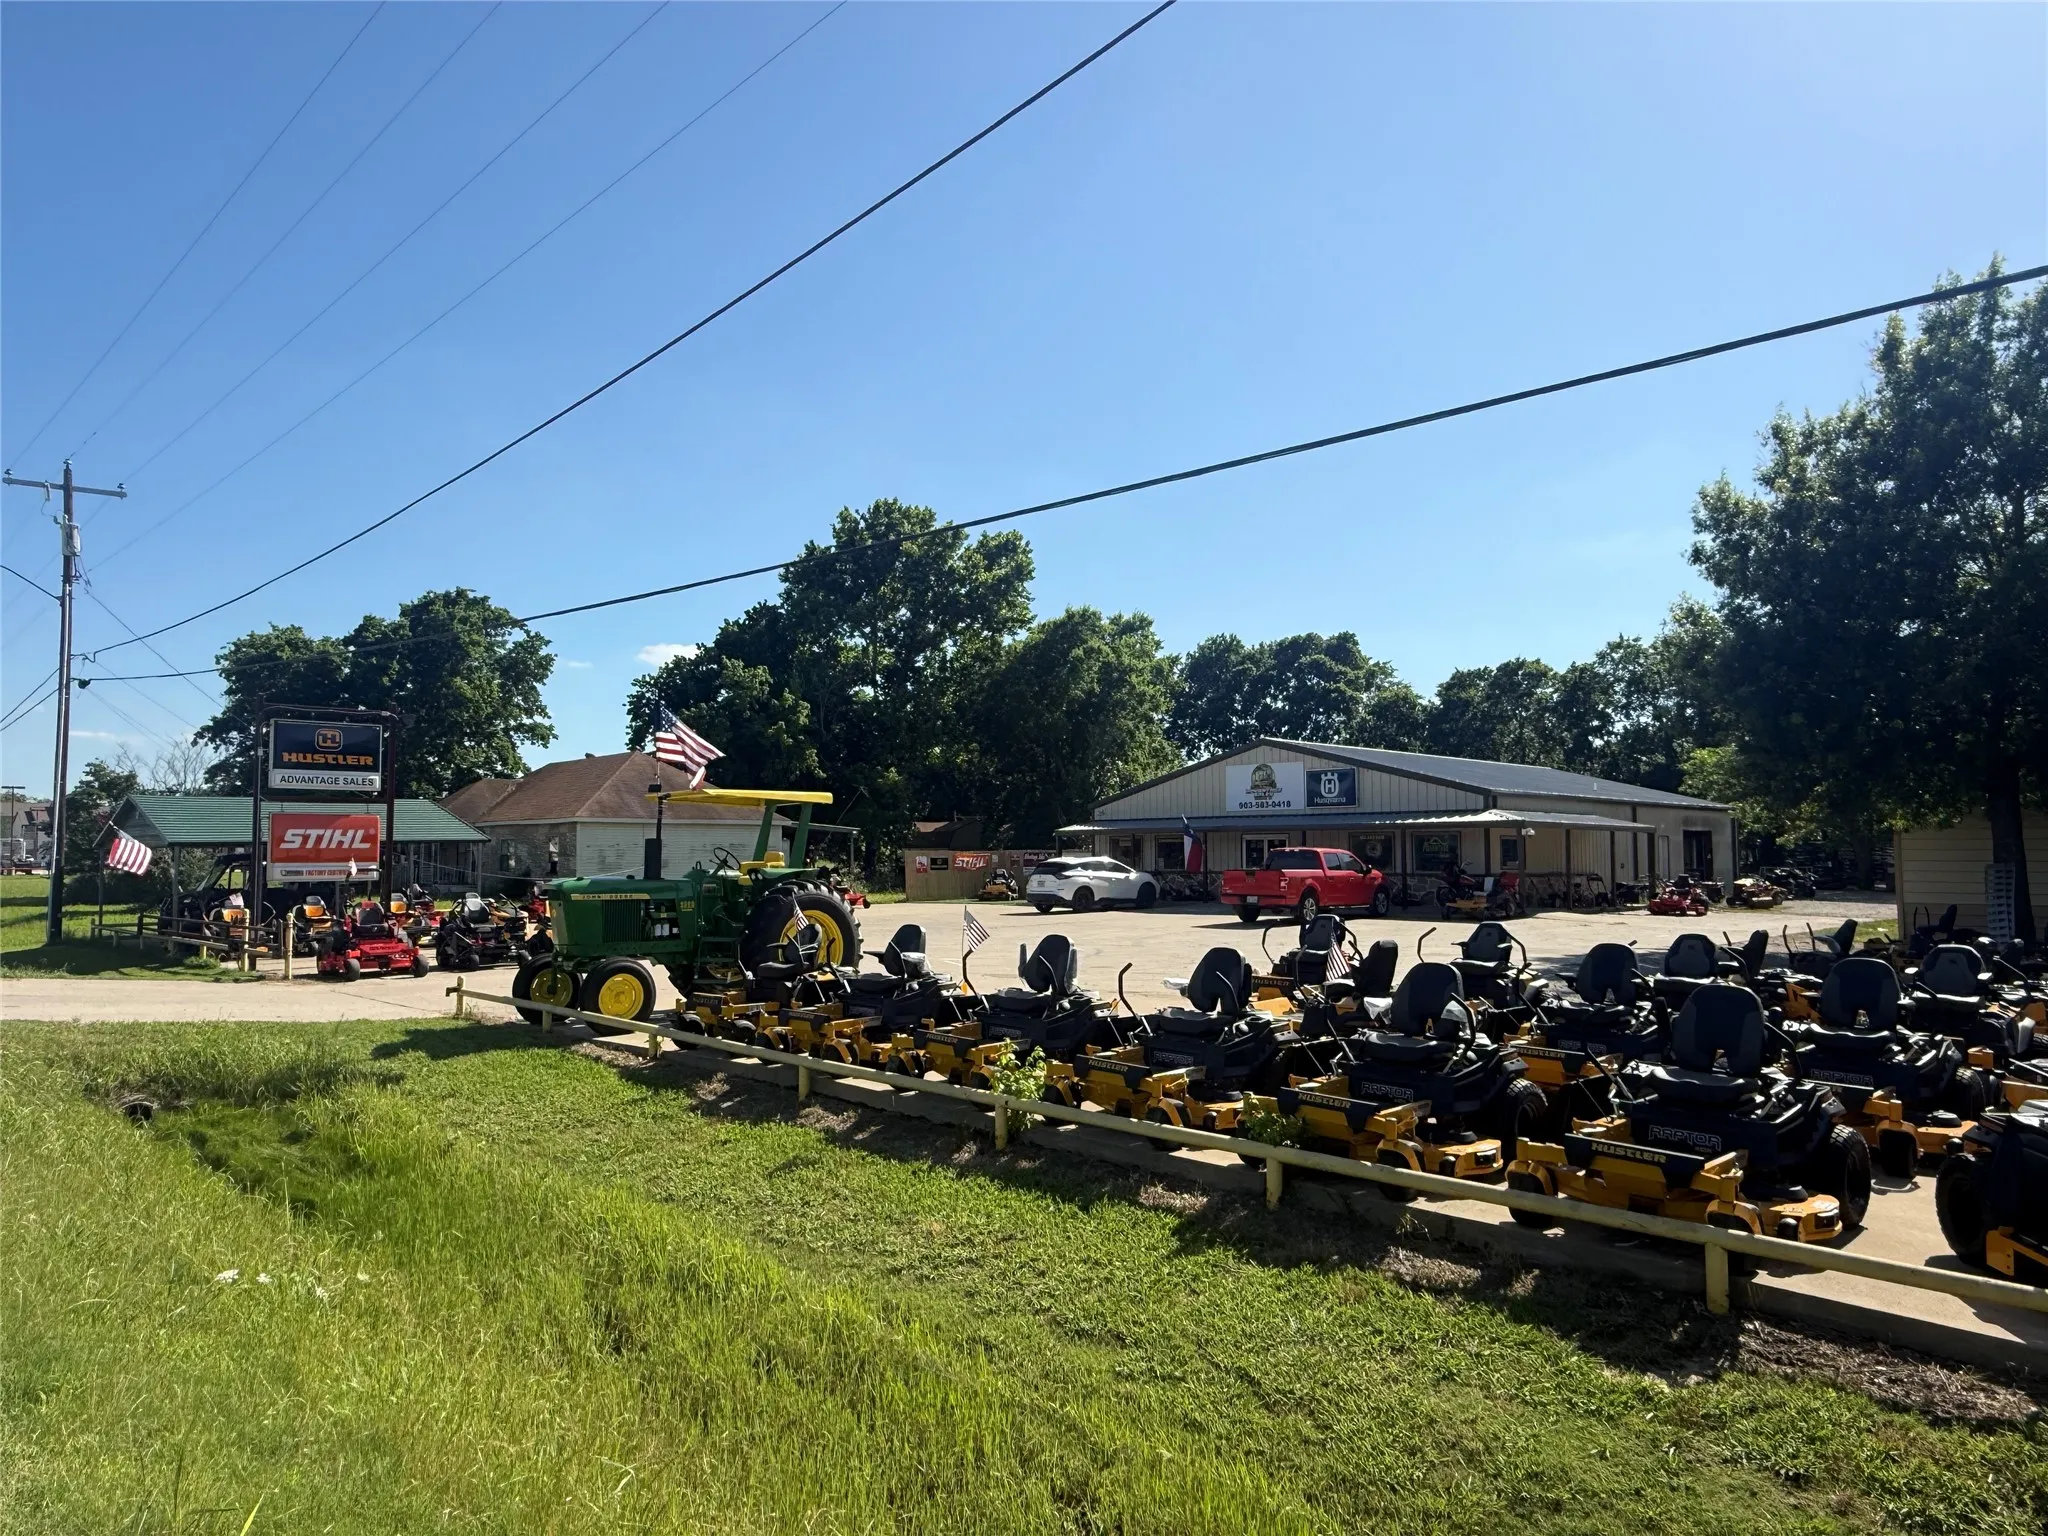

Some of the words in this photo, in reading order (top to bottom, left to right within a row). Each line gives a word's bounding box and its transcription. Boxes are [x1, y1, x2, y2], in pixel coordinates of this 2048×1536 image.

[282, 752, 374, 766] HUSTLER
[280, 775, 340, 786] ADVANTAGE
[343, 777, 374, 787] SALES
[1314, 796, 1346, 805] Husqvarna
[279, 829, 372, 849] STIHL
[954, 857, 986, 868] STIHL
[1557, 1039, 1607, 1054] RAPOR
[1088, 1058, 1129, 1072] HUSTLER
[1152, 1051, 1195, 1066] RAPTOR
[1810, 1067, 1875, 1087] RAPTOR
[1361, 1081, 1414, 1103] RAPTOR
[1298, 1091, 1352, 1109] HUSTLER
[1648, 1124, 1722, 1152] RAPTOR
[1591, 1141, 1667, 1164] HUSTLER
